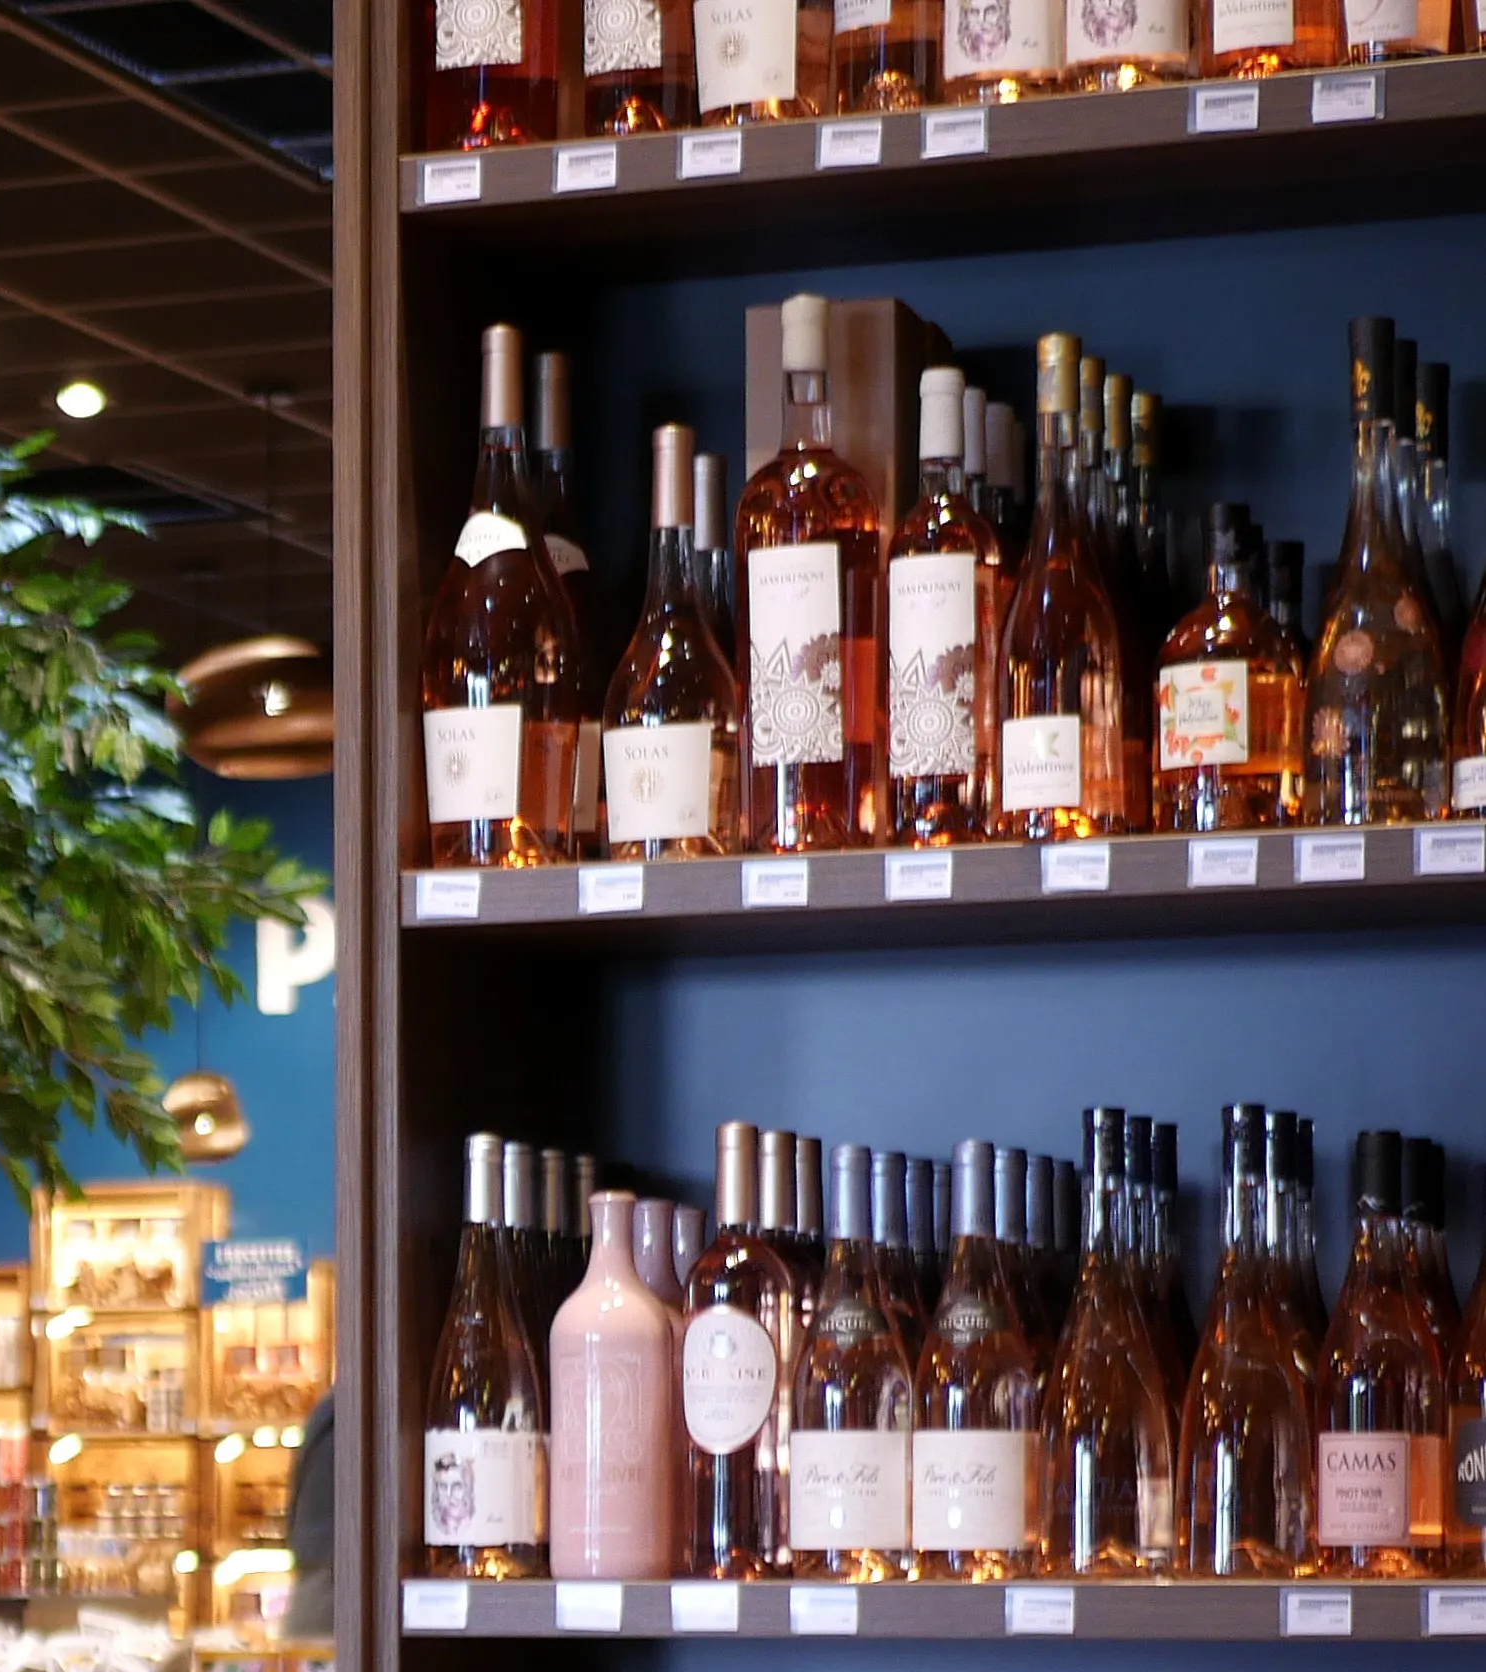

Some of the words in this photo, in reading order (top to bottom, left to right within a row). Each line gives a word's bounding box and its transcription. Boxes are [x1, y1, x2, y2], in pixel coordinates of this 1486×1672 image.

[710, 7, 753, 24] SOLAS
[436, 727, 476, 744] SOLAS
[624, 744, 670, 762] SOLAS
[1326, 1451, 1397, 1473] CAMAS
